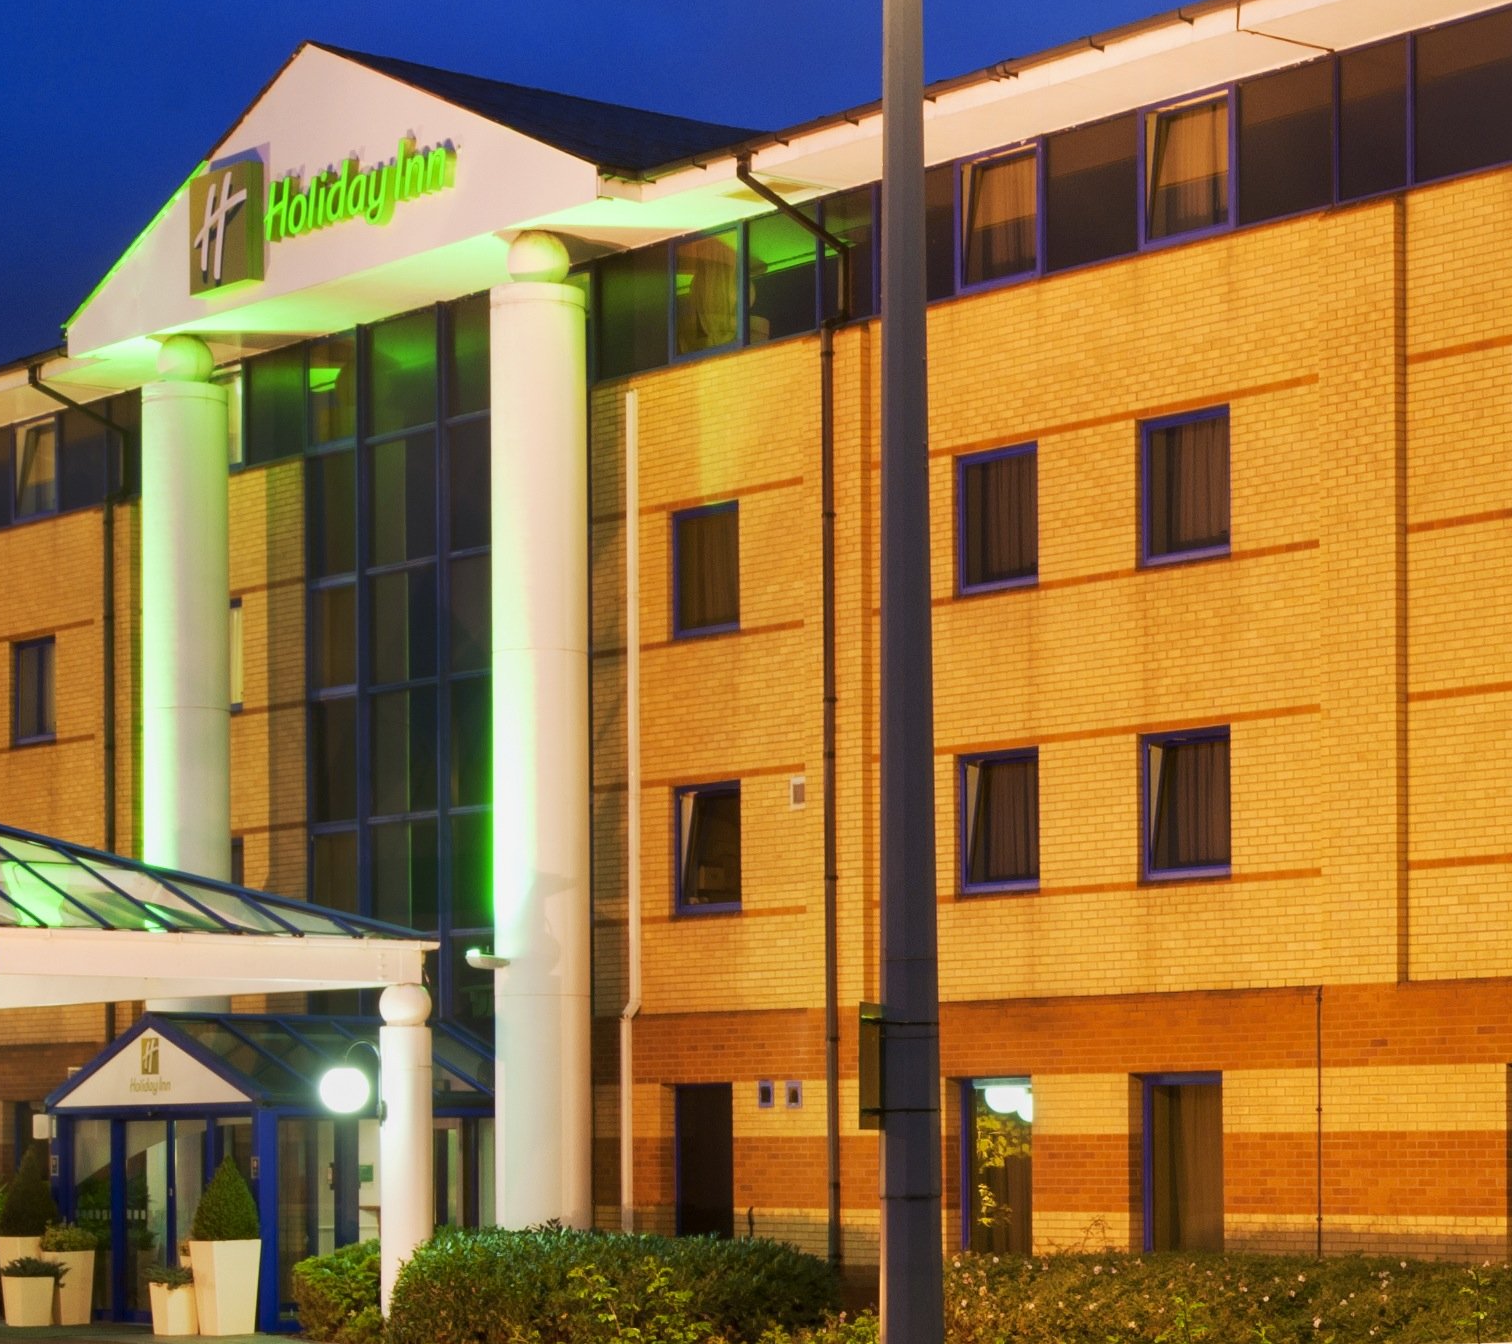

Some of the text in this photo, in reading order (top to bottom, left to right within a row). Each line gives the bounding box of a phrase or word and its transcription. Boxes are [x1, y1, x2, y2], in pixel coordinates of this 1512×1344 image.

[264, 137, 446, 242] Holiday Inn
[129, 1076, 172, 1096] Holiday Inn
